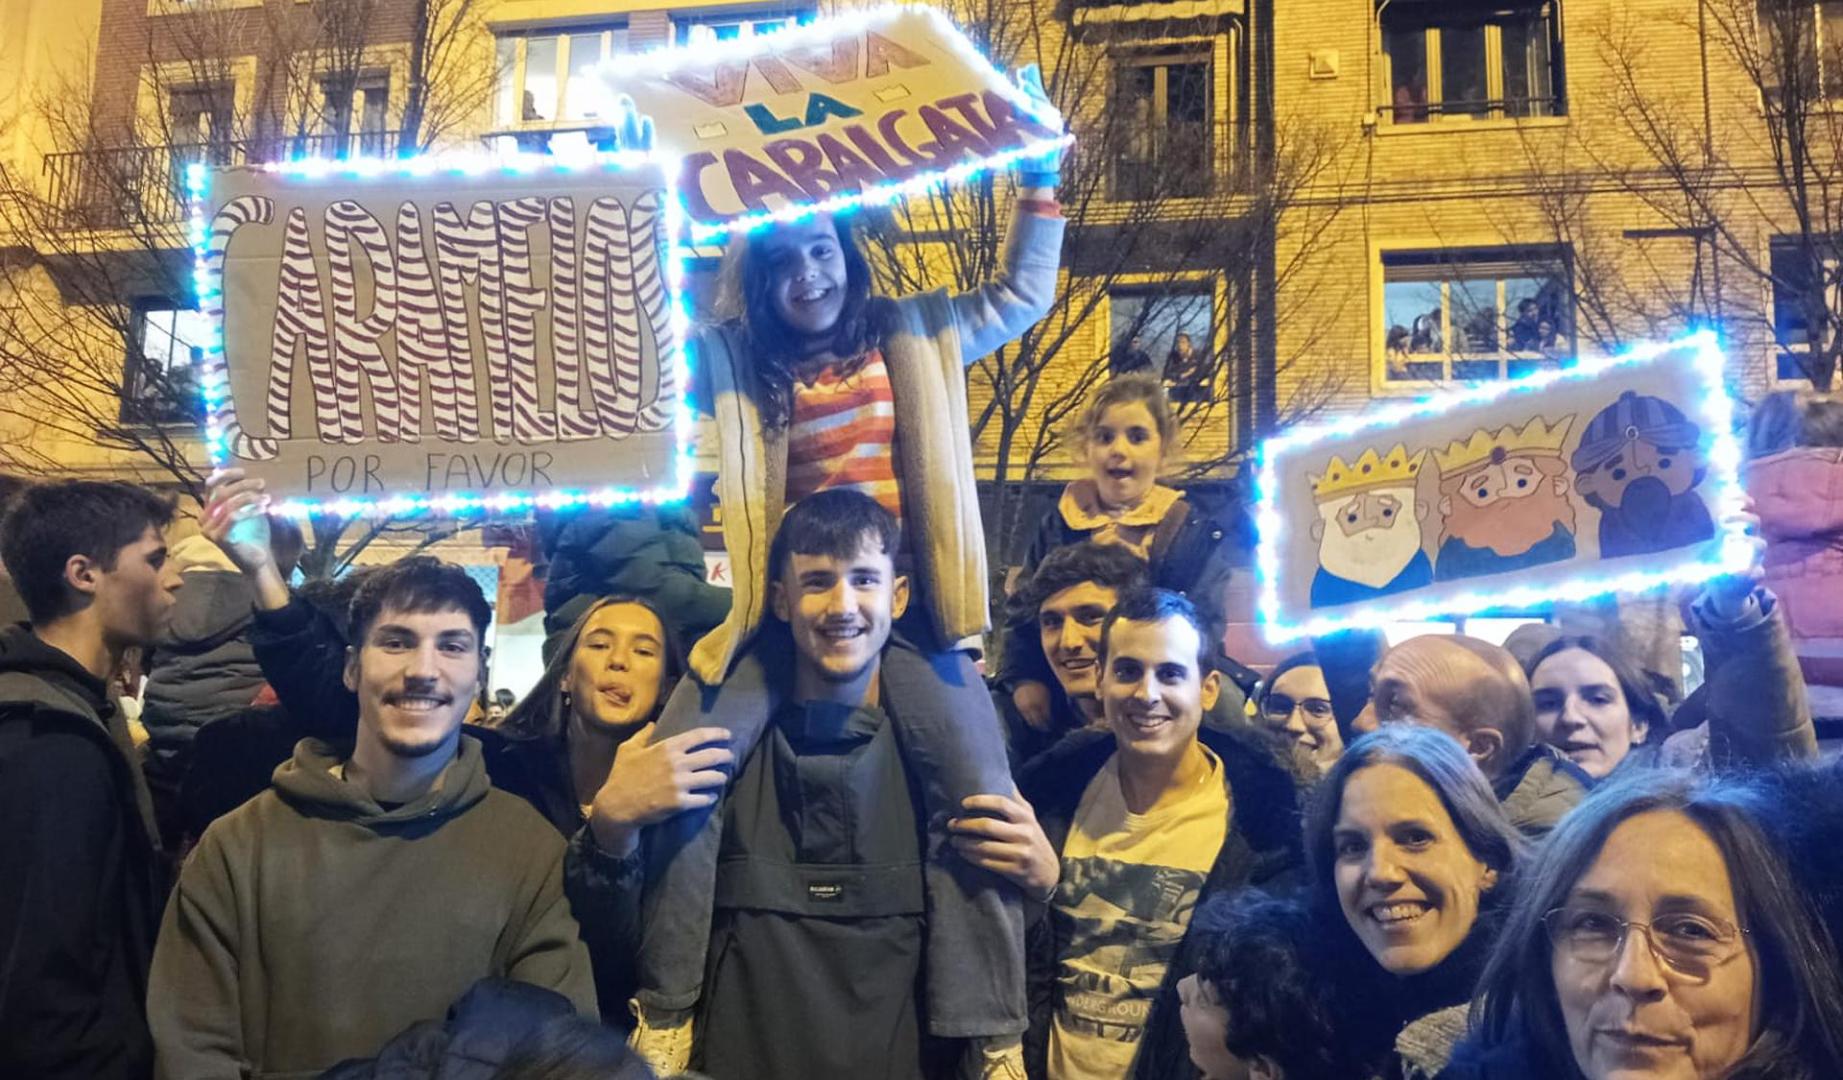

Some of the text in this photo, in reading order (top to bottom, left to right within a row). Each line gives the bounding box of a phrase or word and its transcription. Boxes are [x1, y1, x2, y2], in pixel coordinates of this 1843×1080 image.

[661, 28, 932, 107] VIVA
[743, 92, 865, 136] LA
[677, 89, 1060, 222] CABALGATA
[206, 190, 676, 461] CARAMELOS
[307, 450, 555, 494] POR FAVOR
